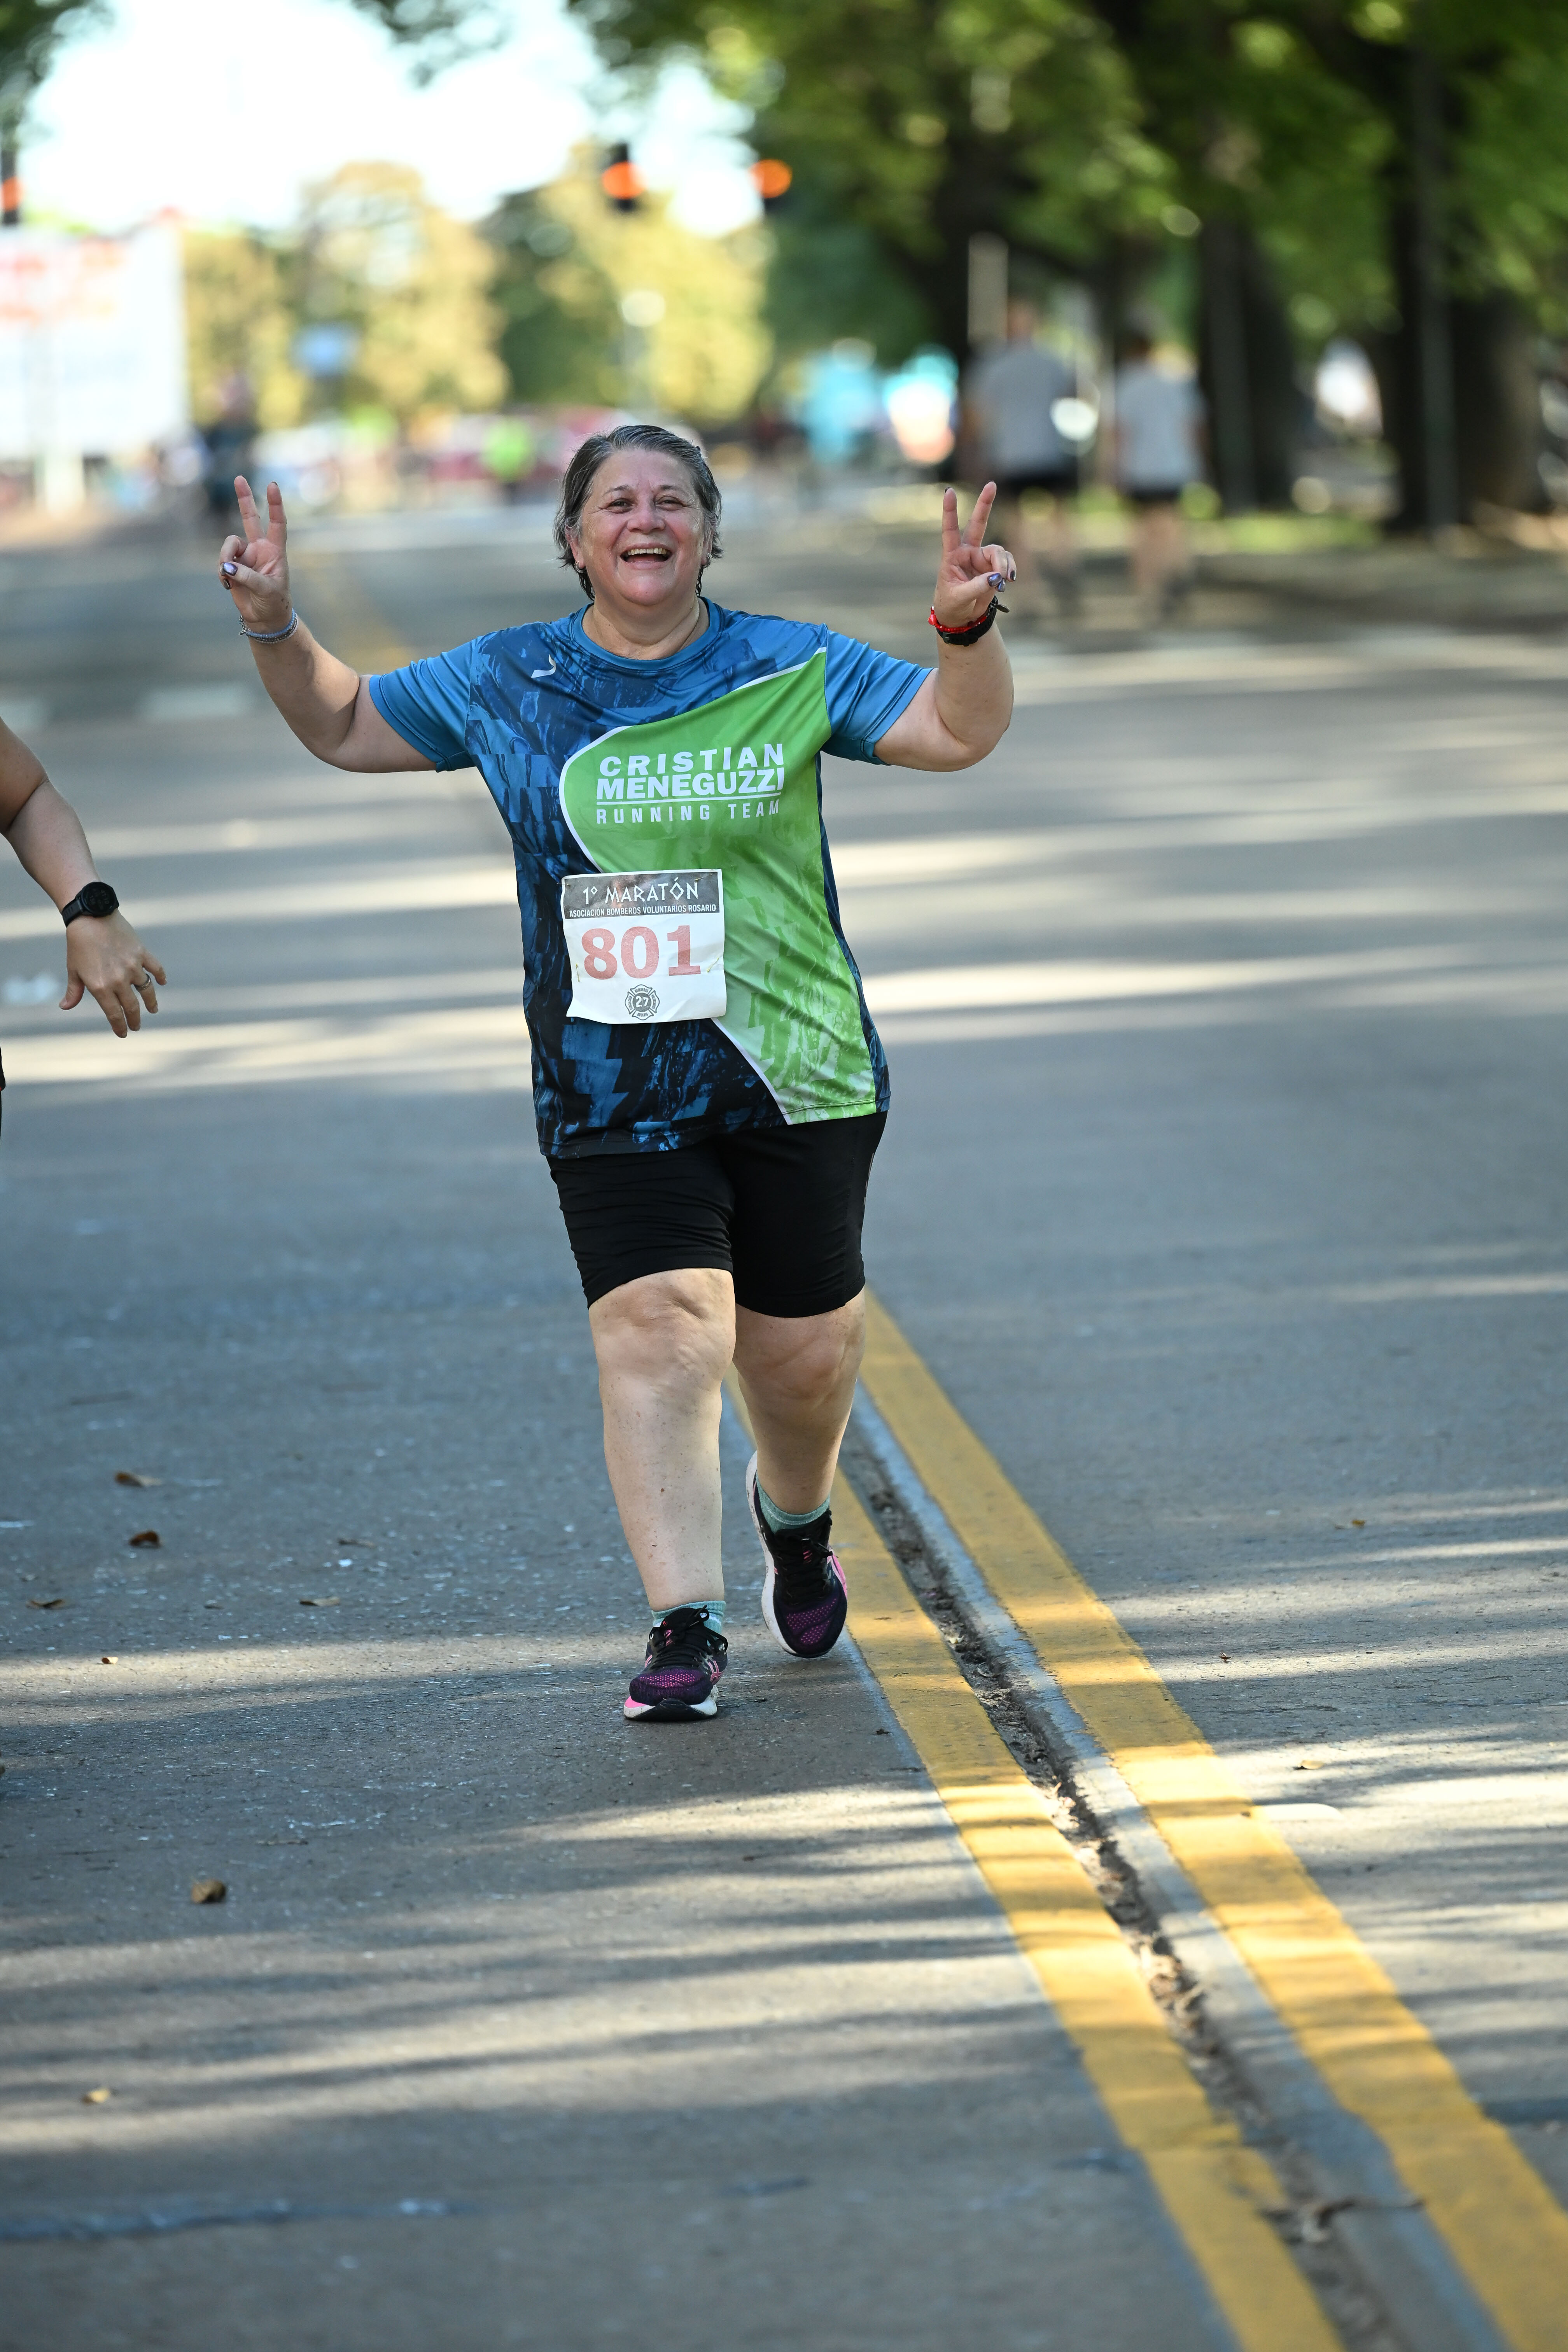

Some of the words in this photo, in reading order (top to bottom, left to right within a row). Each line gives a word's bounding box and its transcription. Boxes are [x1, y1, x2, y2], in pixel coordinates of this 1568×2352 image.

[599, 743, 784, 777] CRISTIAN
[596, 767, 785, 800] MENEGUZZI
[596, 805, 710, 824] RUNNING
[728, 800, 779, 819] TEAM
[605, 877, 698, 903] MARATÓN
[569, 907, 605, 918] ASOCIACIÓN
[606, 906, 641, 915] BOMBEROS
[642, 905, 686, 914] VOLUNTARIOS
[688, 904, 717, 912] ROSARIO
[581, 925, 701, 980] 801
[635, 996, 649, 1008] 27
